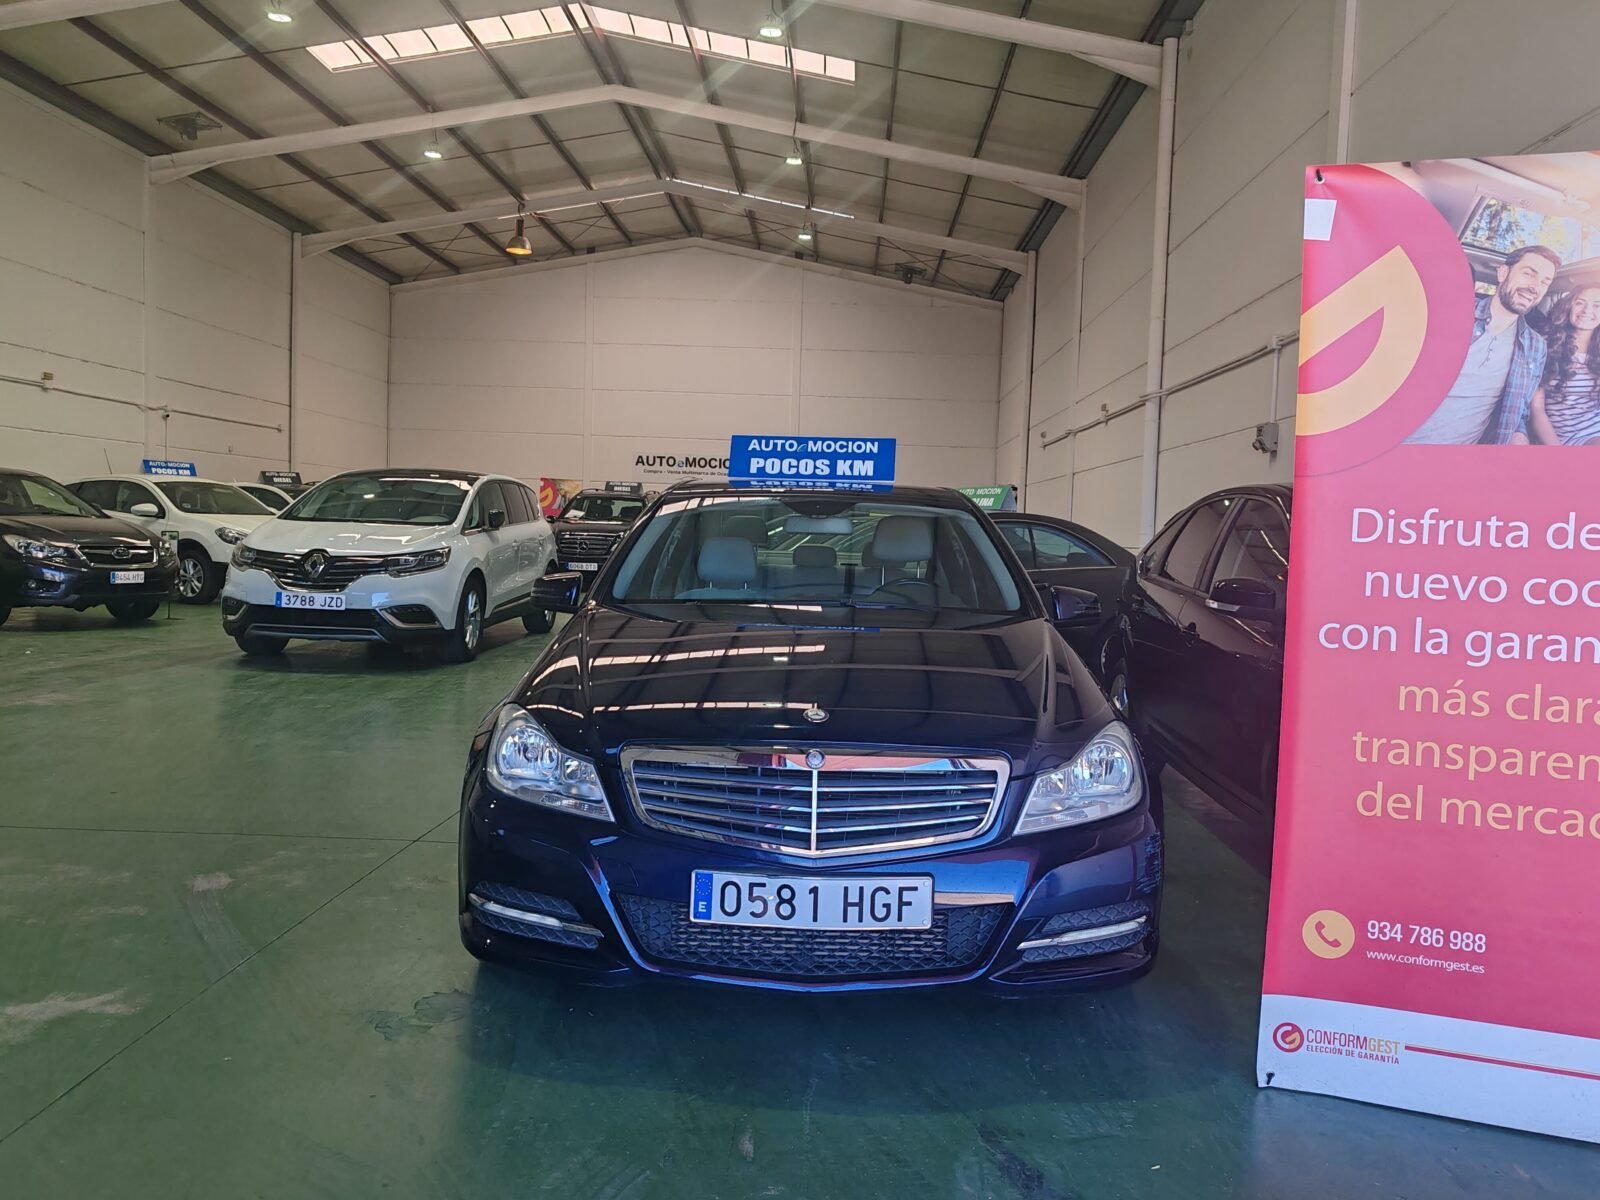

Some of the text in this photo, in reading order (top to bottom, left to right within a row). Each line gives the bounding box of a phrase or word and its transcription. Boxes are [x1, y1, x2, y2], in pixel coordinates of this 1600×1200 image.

[808, 441, 878, 453] MOCION
[151, 467, 178, 475] POCOS
[750, 457, 874, 476] POCOS KM
[1350, 507, 1600, 551] Disfruta de
[284, 594, 343, 608] 3788 JZD
[1364, 570, 1508, 603] nuevo
[1318, 616, 1600, 667] con la garan
[1398, 679, 1491, 717] más
[1352, 731, 1600, 783] transparen
[1356, 781, 1424, 821] del
[698, 901, 707, 913] E
[719, 880, 919, 923] 0581 HGF
[1367, 919, 1487, 953] 934 786 988
[1366, 950, 1486, 974] www.conformgest.es
[1306, 1028, 1401, 1056] CONFORMGEST
[1345, 1049, 1356, 1058] DE
[1358, 1051, 1400, 1065] GARANTÍA
